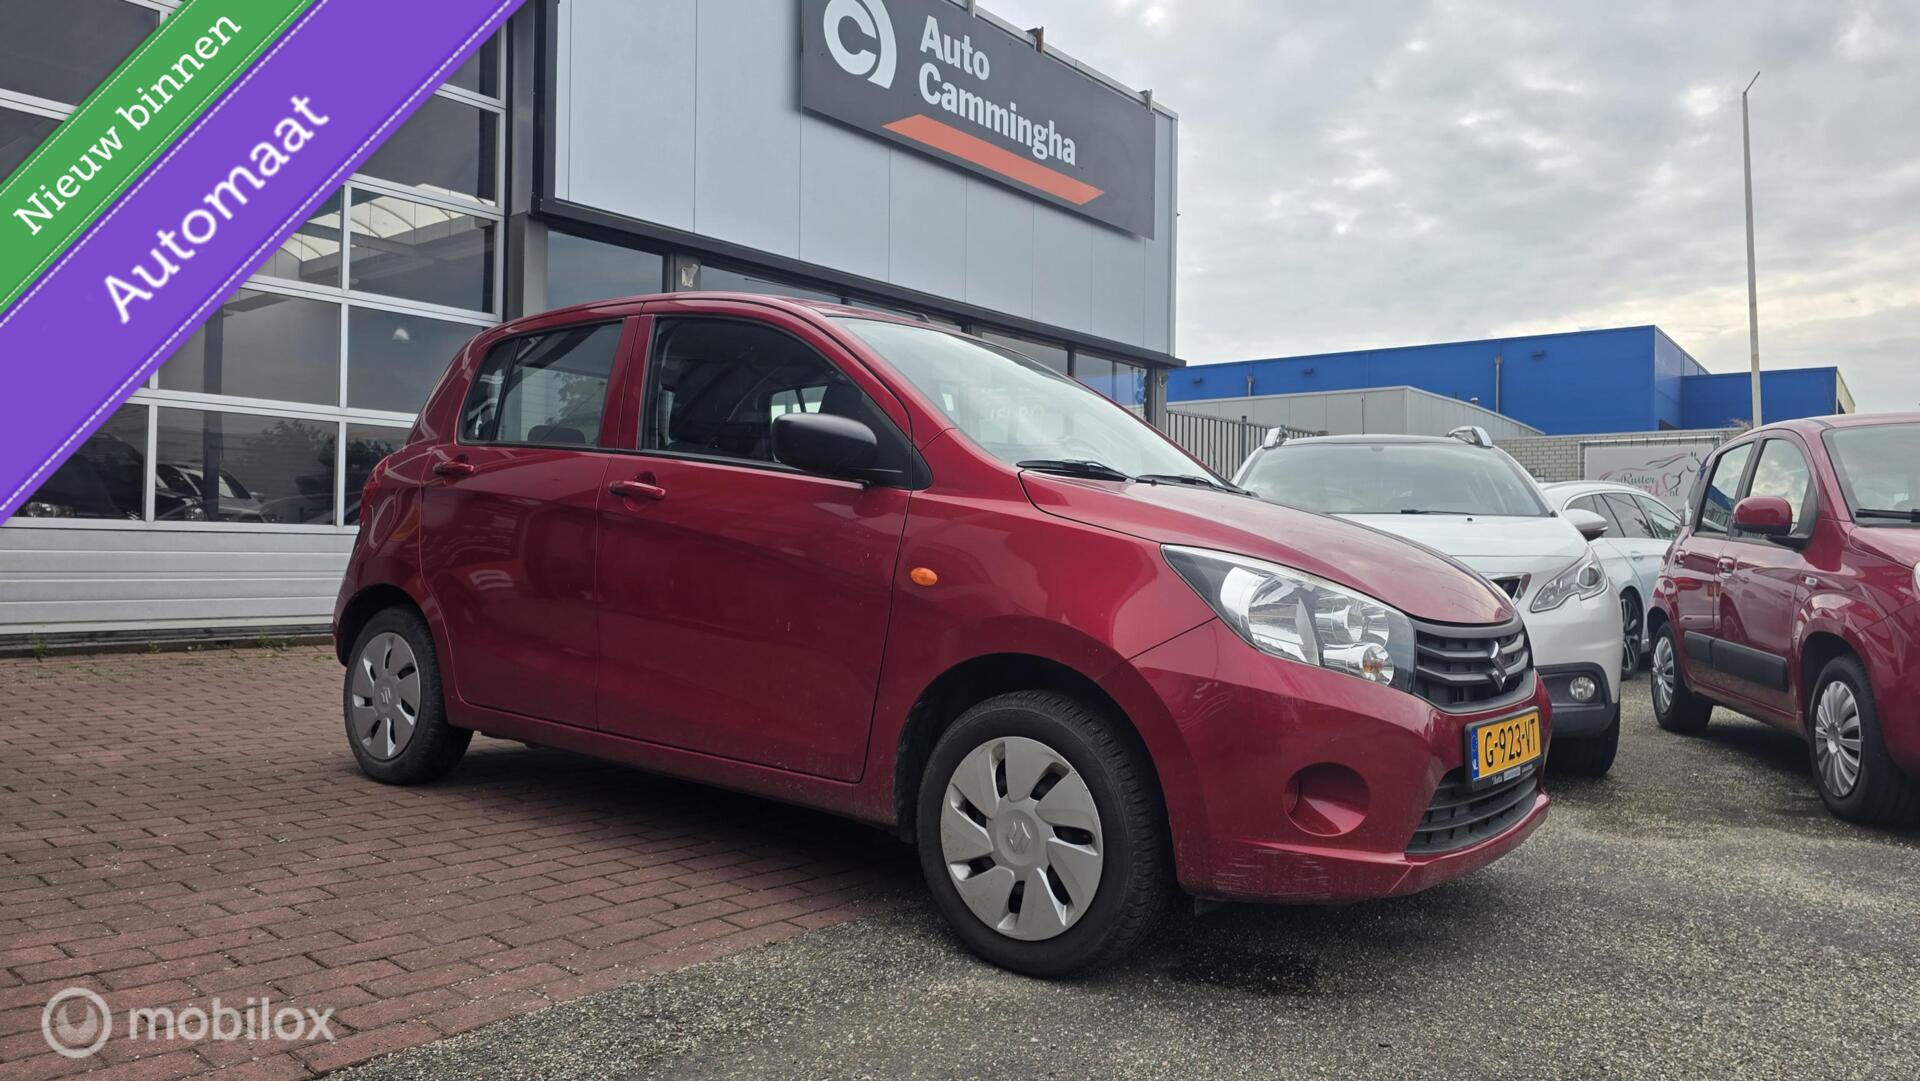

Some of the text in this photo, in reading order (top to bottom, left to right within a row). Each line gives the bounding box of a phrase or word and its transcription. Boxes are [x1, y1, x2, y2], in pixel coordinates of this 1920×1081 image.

[919, 14, 990, 81] Auto
[918, 62, 1076, 166] Cammingha
[1484, 717, 1537, 769] G-923-VT
